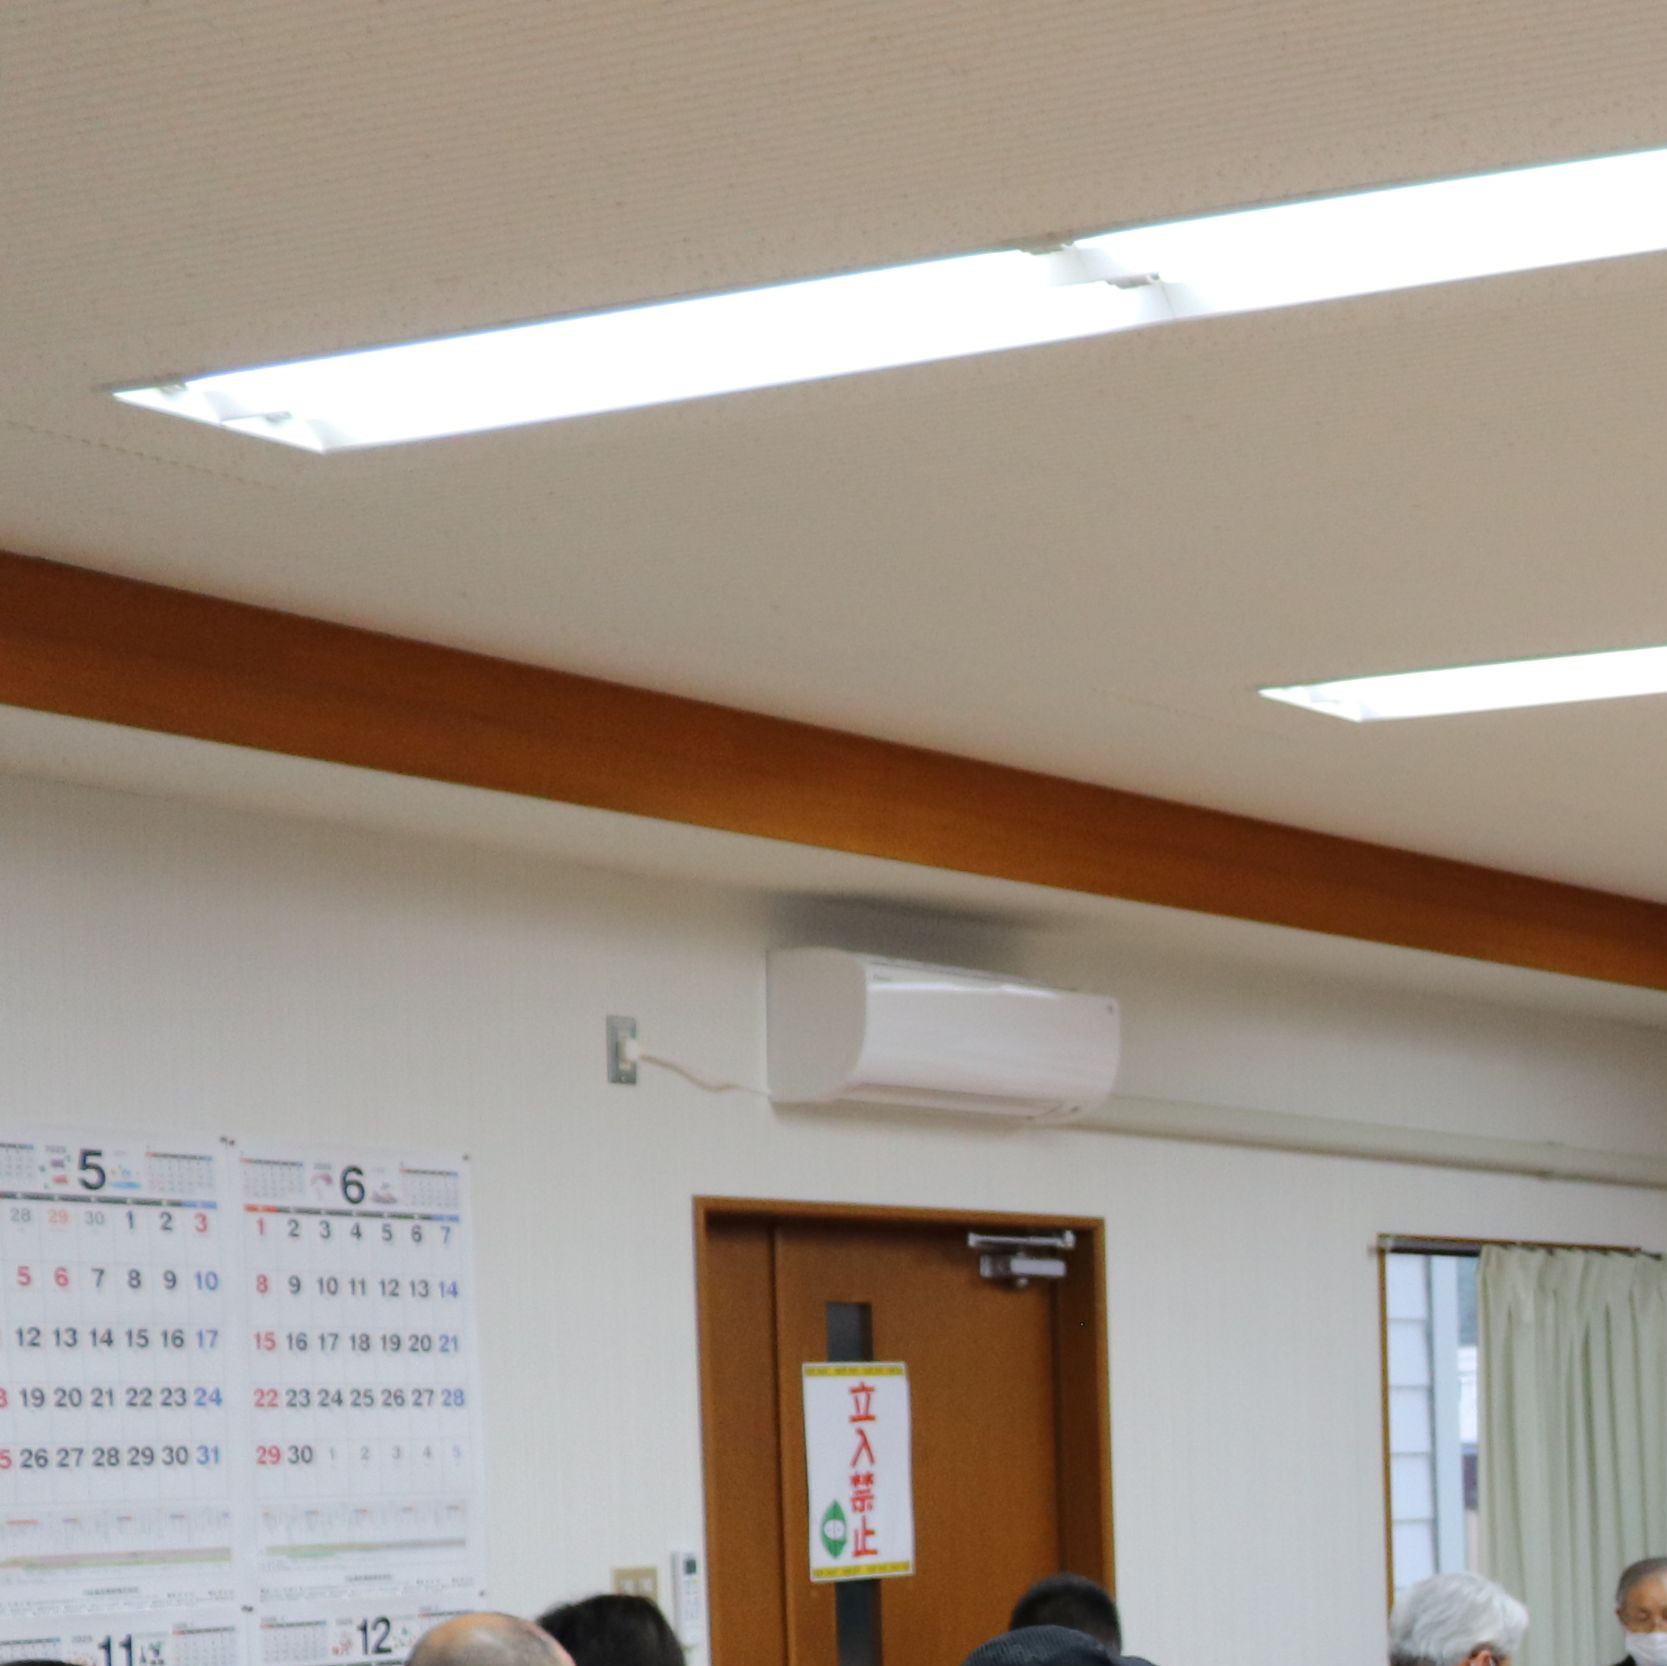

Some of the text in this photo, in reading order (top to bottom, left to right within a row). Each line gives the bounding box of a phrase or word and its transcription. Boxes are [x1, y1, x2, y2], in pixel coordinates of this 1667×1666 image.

[79, 1149, 107, 1191] 5
[340, 1165, 366, 1205] 6
[126, 1210, 135, 1230] 1
[159, 1211, 173, 1232] 2
[195, 1212, 209, 1234] 3
[256, 1216, 452, 1244] 1 2 3 4 5 6 7
[17, 1265, 221, 1292] 5 6 7 8 9 10
[255, 1273, 460, 1299] 8 9 10 11 12 13 14
[16, 1326, 219, 1349] 12 13 14 15 16 17
[254, 1331, 459, 1354] 15 16 17 18 19 20 21
[20, 1387, 46, 1409] 19
[54, 1387, 83, 1409] 20
[91, 1387, 114, 1409] 21
[126, 1387, 153, 1408] 22
[160, 1387, 188, 1408] 23
[193, 1387, 224, 1407] 24
[253, 1387, 466, 1409] 22 23 24 25 26 27 28
[0, 1444, 221, 1470] 5 26 27 28 29 30 31
[256, 1445, 282, 1466] 29
[287, 1445, 314, 1465] 30
[848, 1381, 879, 1558] 立入禁止
[358, 1615, 393, 1656] 12
